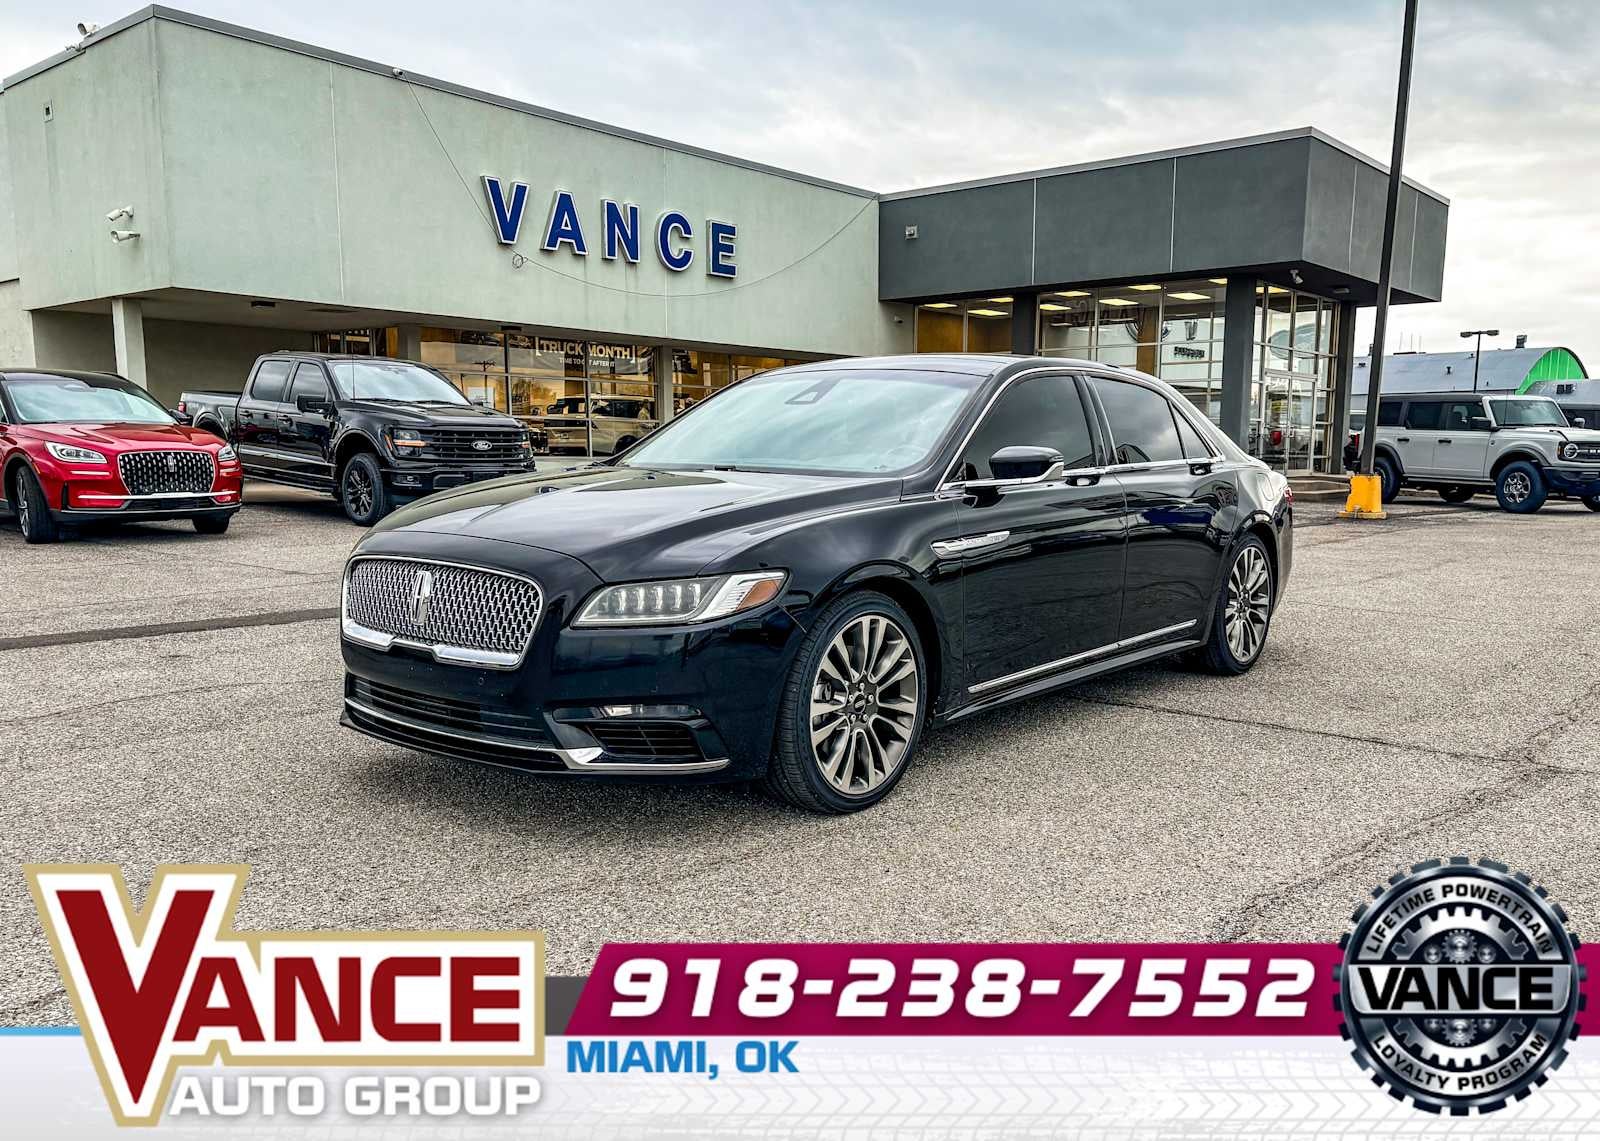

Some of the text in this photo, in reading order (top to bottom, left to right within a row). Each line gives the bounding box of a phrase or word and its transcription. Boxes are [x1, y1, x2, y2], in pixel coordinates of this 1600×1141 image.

[480, 175, 738, 278] VANCE
[540, 340, 630, 359] TRUCK MONTH
